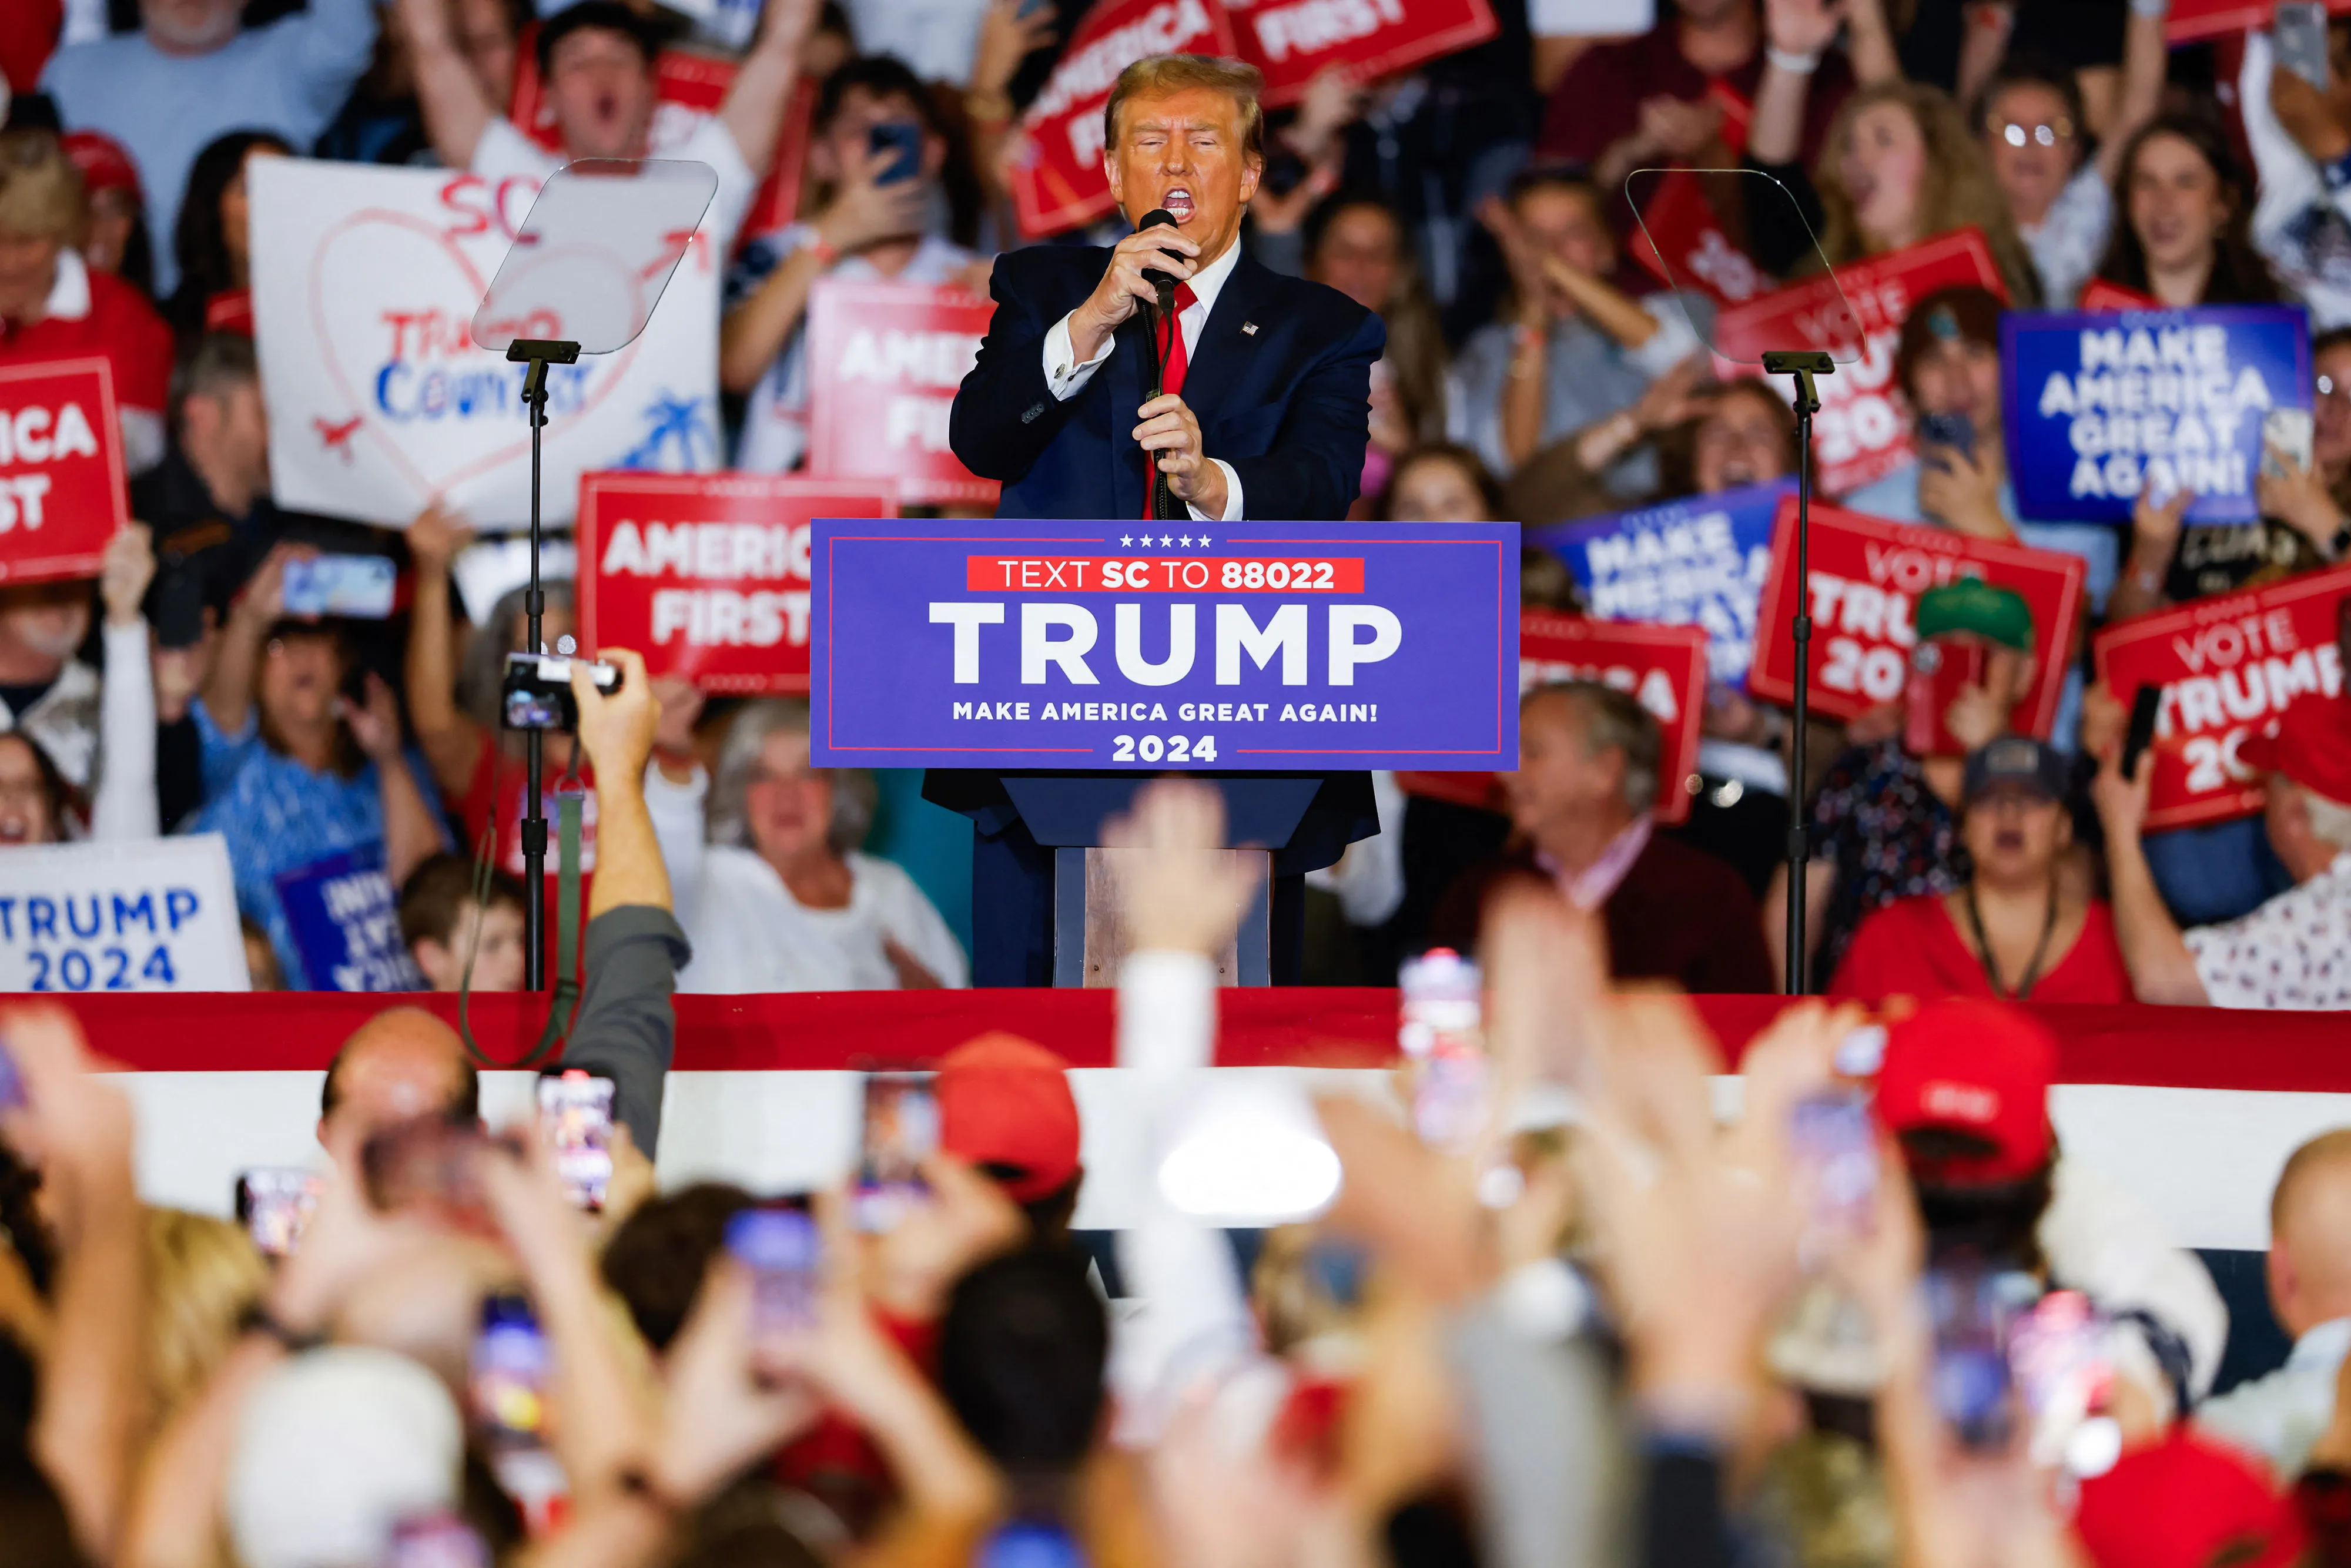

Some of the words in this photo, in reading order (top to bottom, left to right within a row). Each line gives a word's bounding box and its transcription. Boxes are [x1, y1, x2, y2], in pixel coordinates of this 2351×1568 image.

[438, 174, 544, 245] SC
[2079, 324, 2228, 371] MAKE
[2039, 366, 2272, 418] AMERICA
[2069, 411, 2242, 458] GREAT
[2071, 453, 2246, 500] AGAIN!
[601, 519, 811, 581] AMERIC
[997, 560, 1090, 588] TEXT
[1101, 561, 1150, 589] SC
[1160, 561, 1210, 589] TO
[1221, 561, 1334, 589] 88022
[651, 588, 811, 647] FIRST
[2172, 607, 2299, 673] VOTE
[929, 602, 1403, 687] TRUMP
[953, 702, 1030, 721] MAKE
[1041, 702, 1168, 721] AMERICA
[1178, 703, 1270, 722] GREAT
[1280, 703, 1378, 723] AGAIN!
[1111, 734, 1218, 763] 2024
[0, 888, 200, 940] TRUMP
[27, 944, 176, 991] 2024
